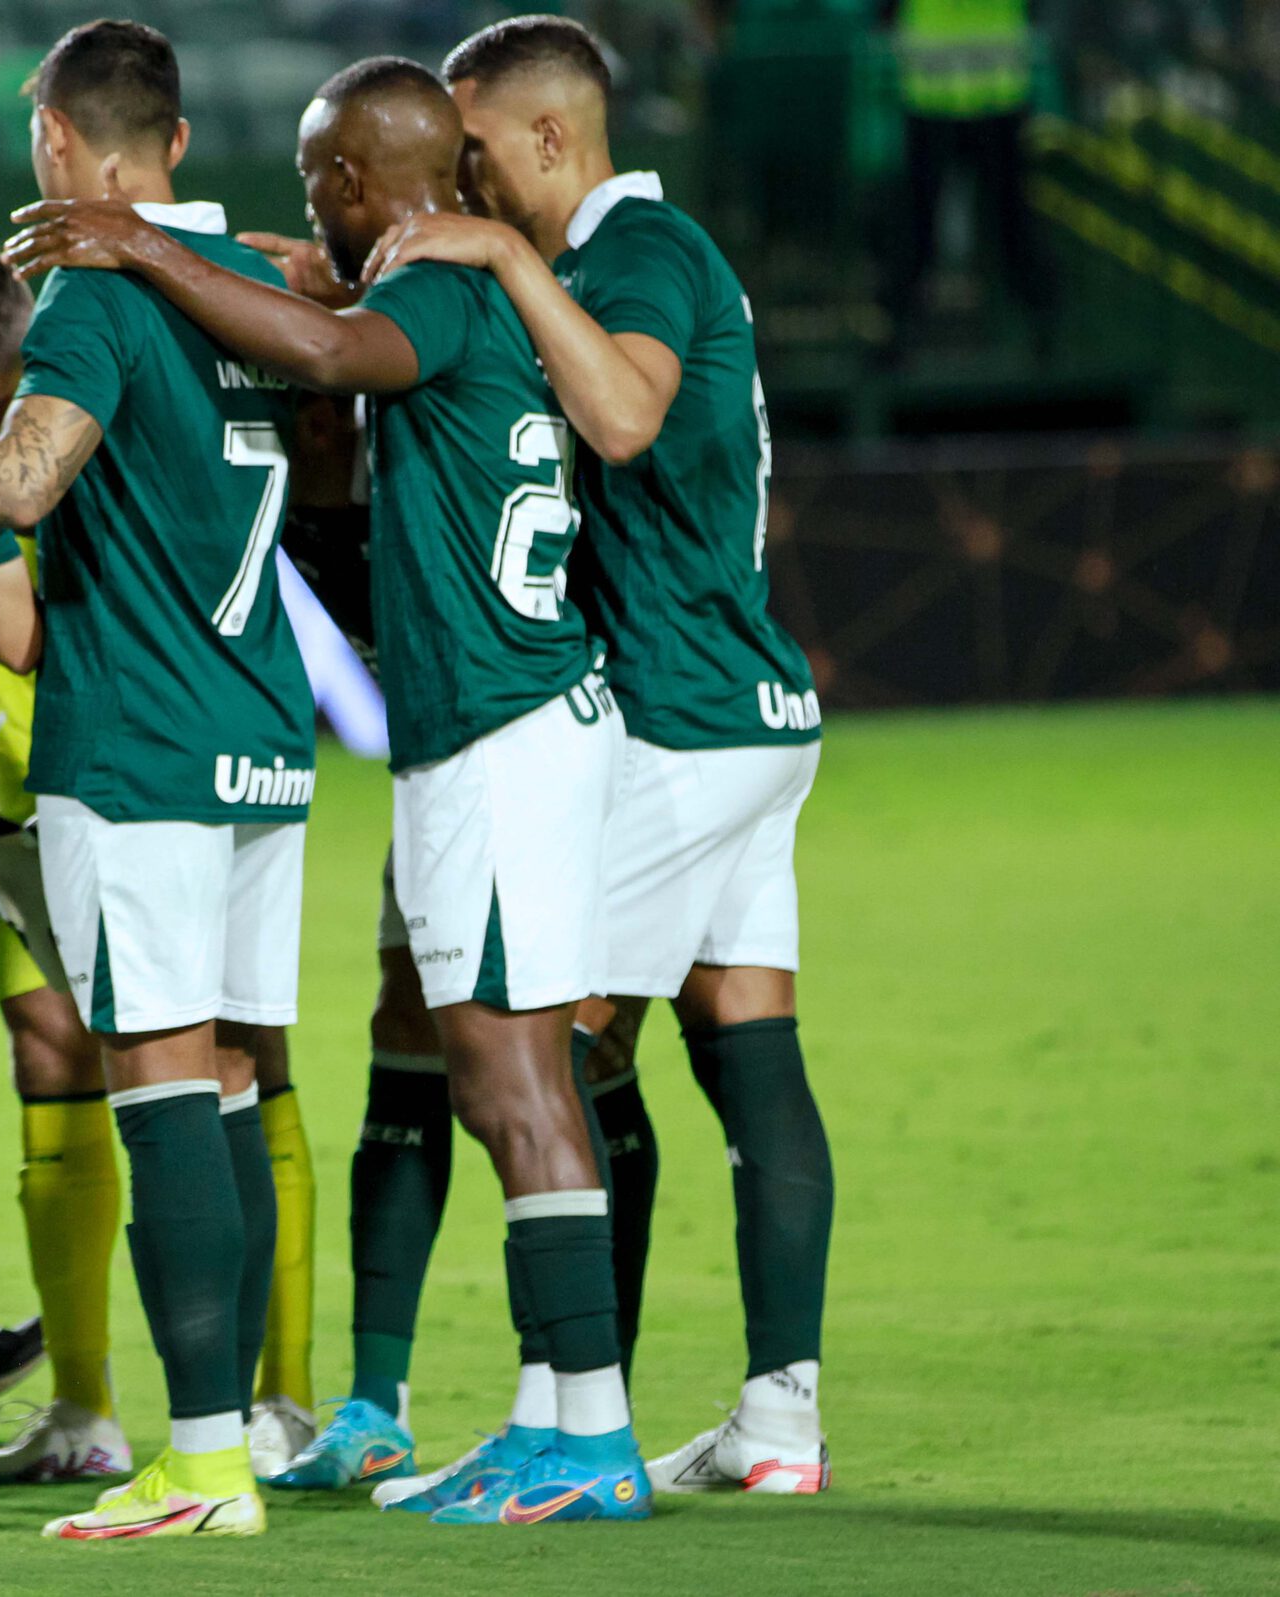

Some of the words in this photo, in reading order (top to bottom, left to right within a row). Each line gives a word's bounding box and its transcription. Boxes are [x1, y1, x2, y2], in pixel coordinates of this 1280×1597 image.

[211, 421, 289, 637] 7
[491, 412, 581, 621] 2
[214, 753, 317, 807] Unim
